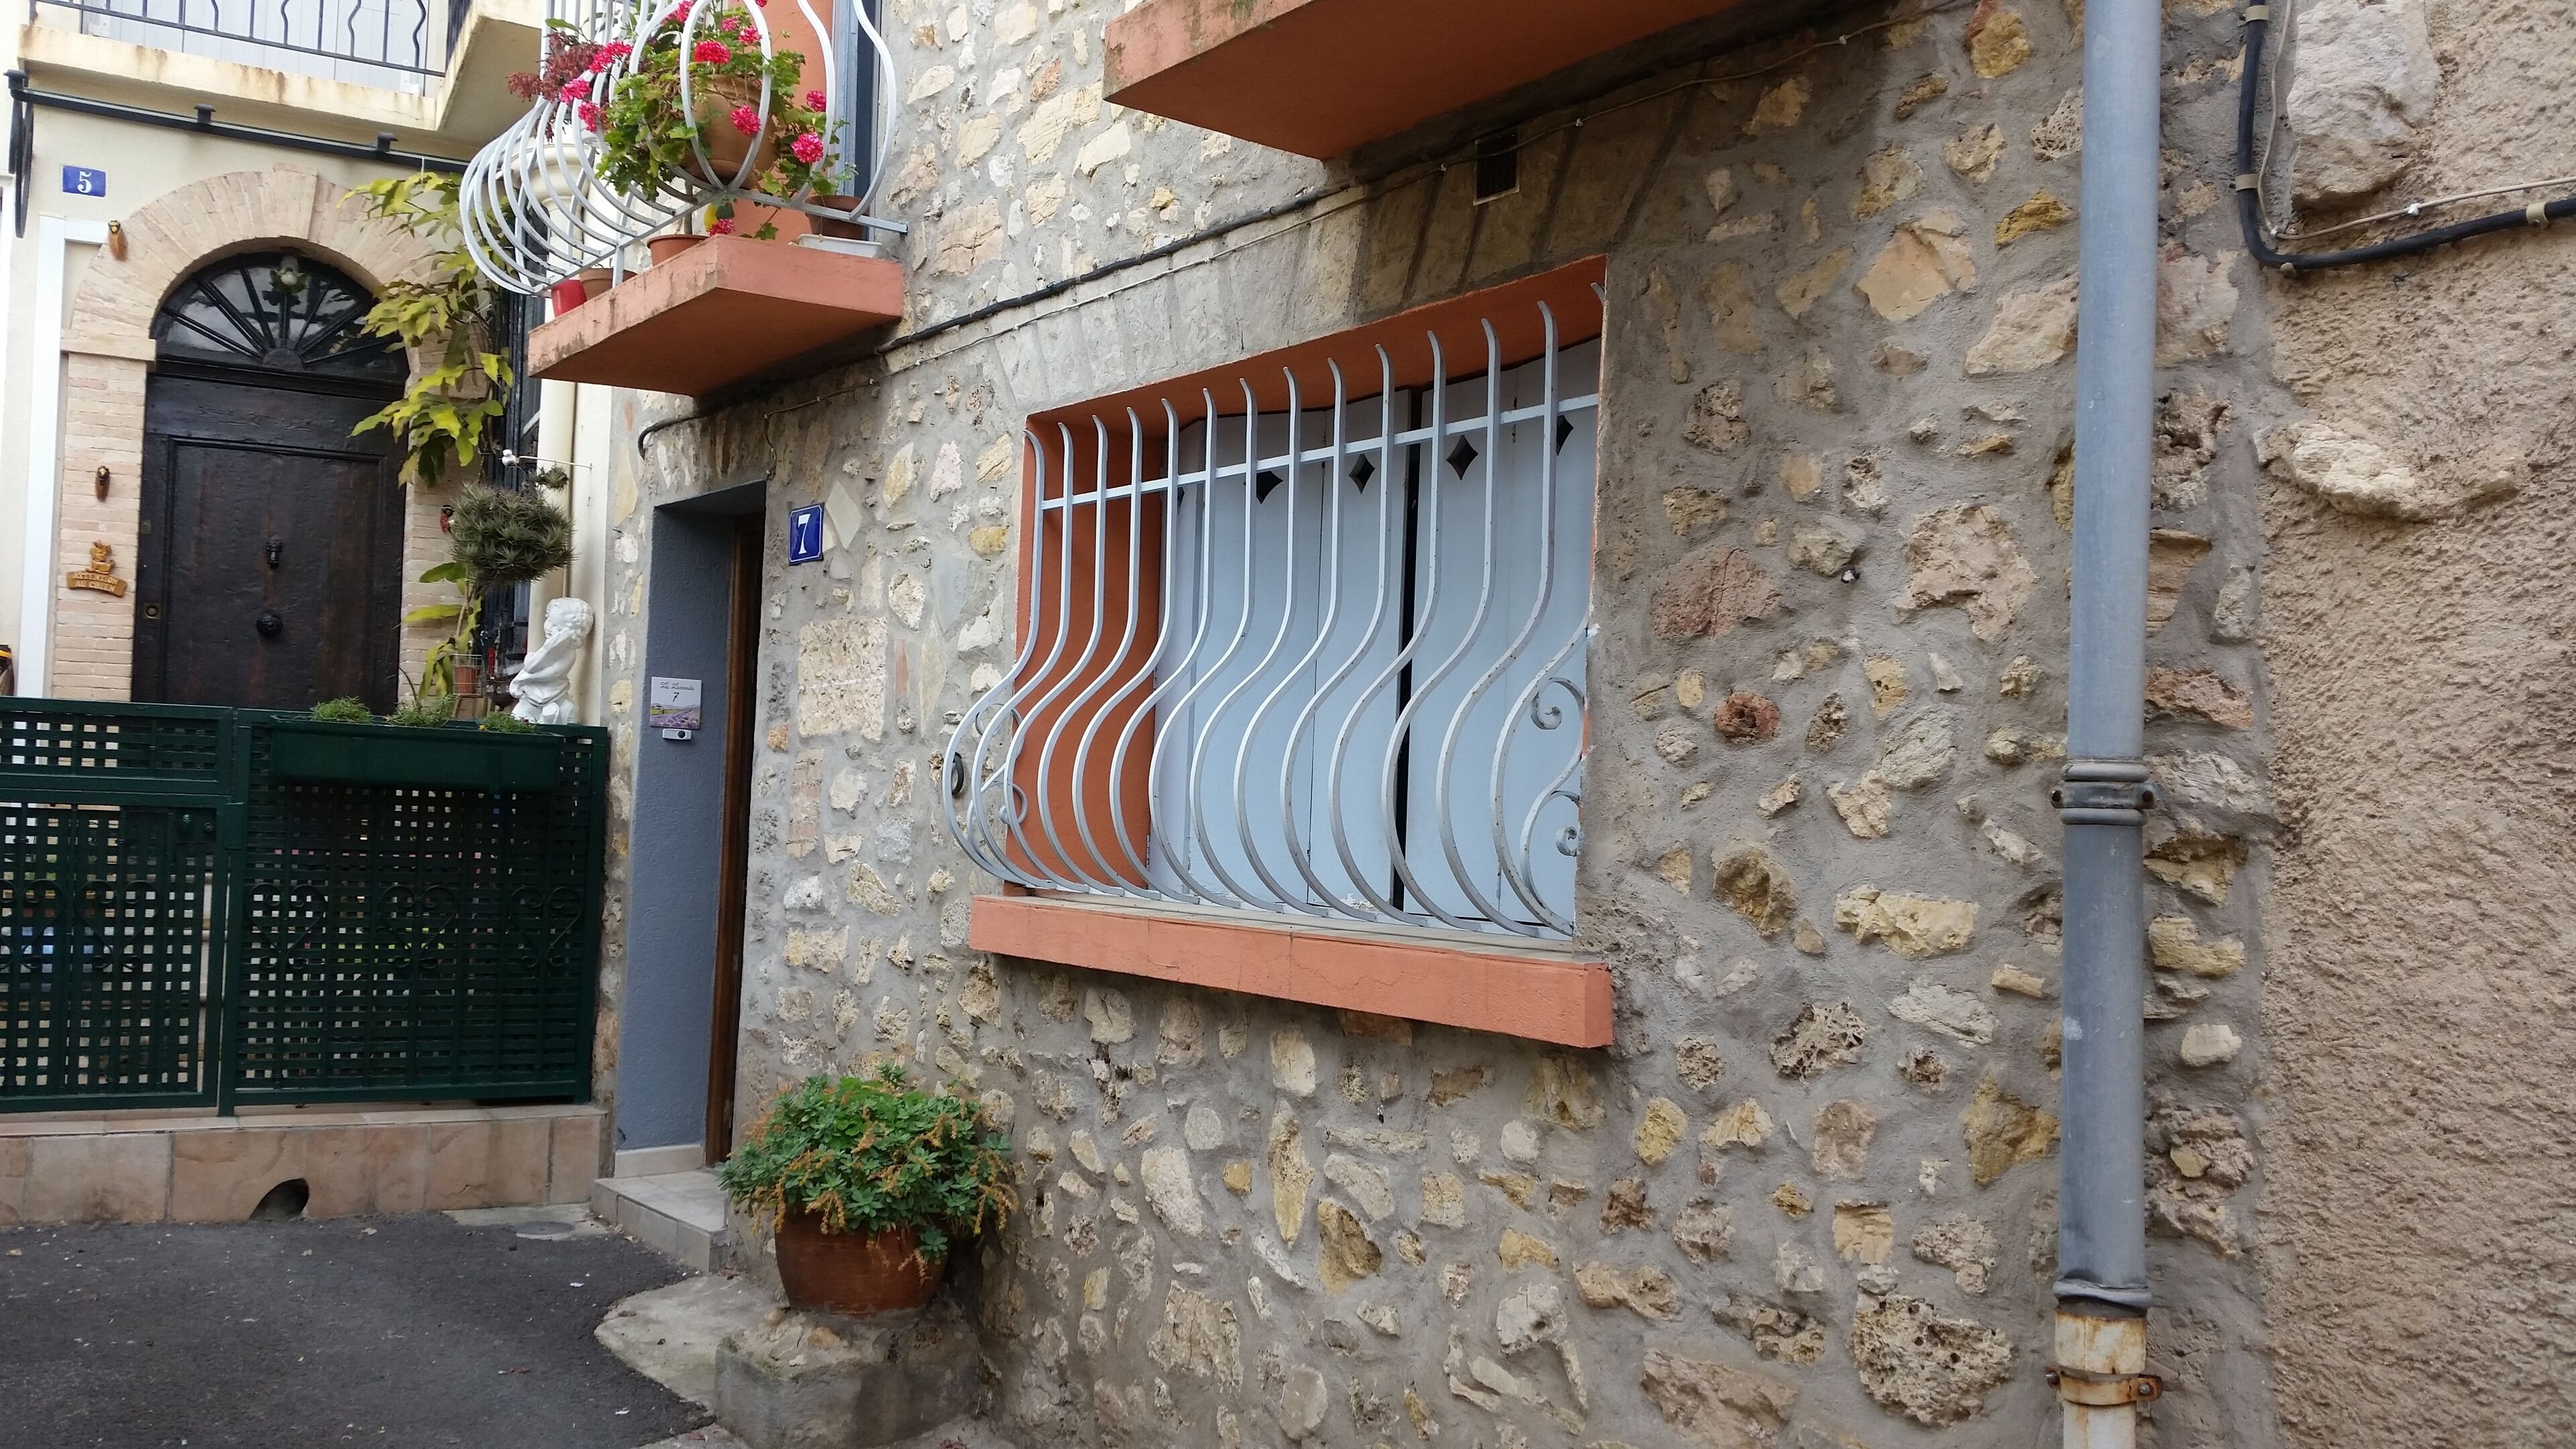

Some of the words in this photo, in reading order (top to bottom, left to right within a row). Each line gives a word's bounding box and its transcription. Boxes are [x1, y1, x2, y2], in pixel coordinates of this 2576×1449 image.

[77, 170, 92, 194] 5
[798, 513, 811, 555] 7
[72, 572, 119, 586] ATTENTION
[89, 581, 115, 592] CHIEN
[672, 692, 680, 702] 7
